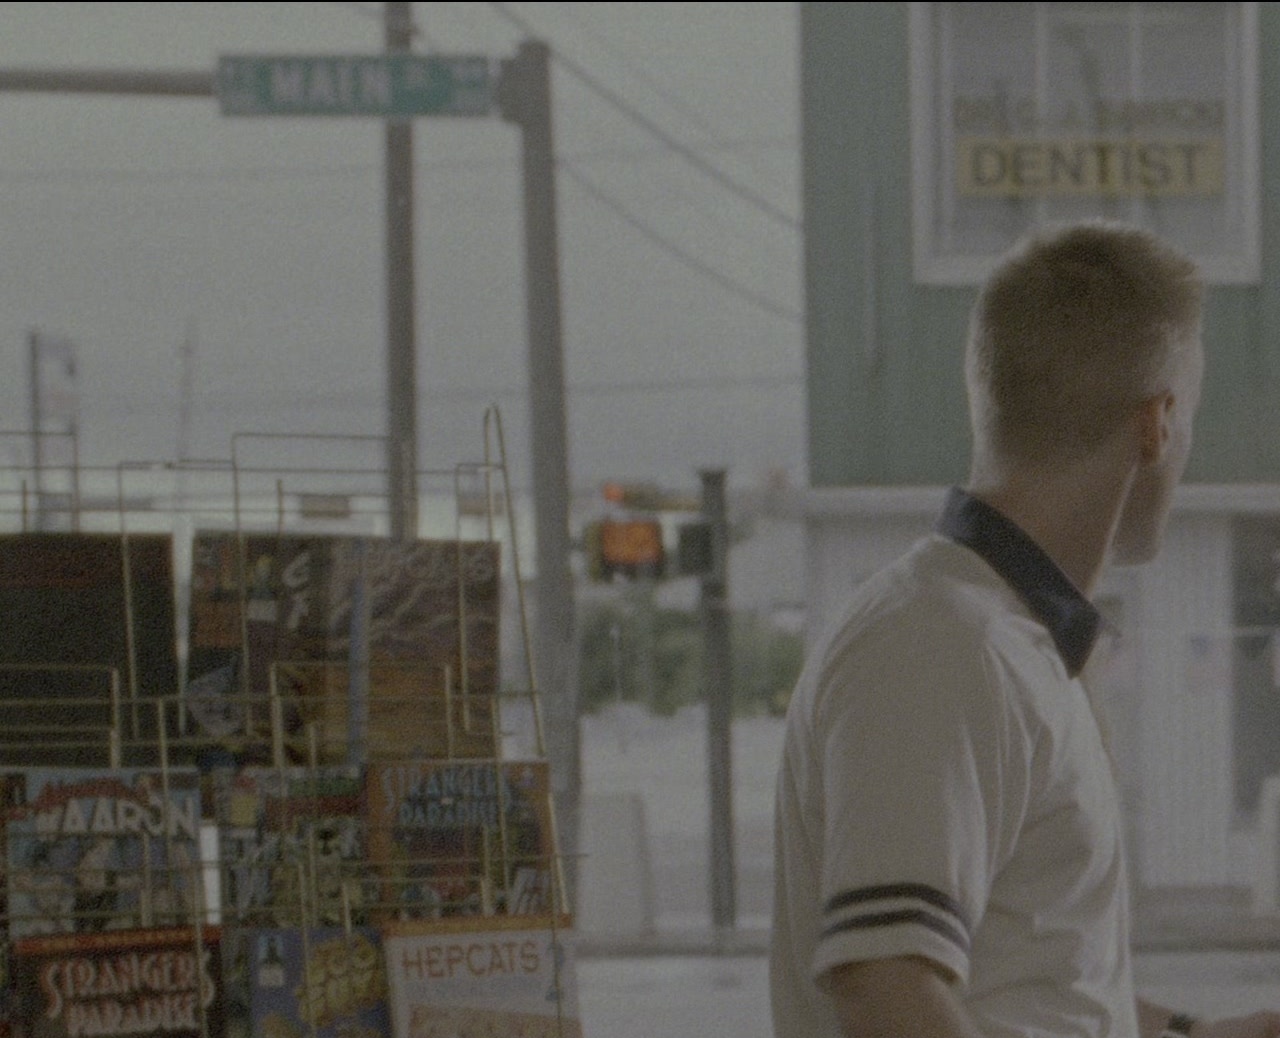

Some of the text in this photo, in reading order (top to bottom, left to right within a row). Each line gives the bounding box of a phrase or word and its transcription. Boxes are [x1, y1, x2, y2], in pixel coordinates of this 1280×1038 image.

[270, 60, 392, 106] MAIN
[970, 142, 1202, 188] DENTIST
[402, 940, 538, 982] HEPCATS
